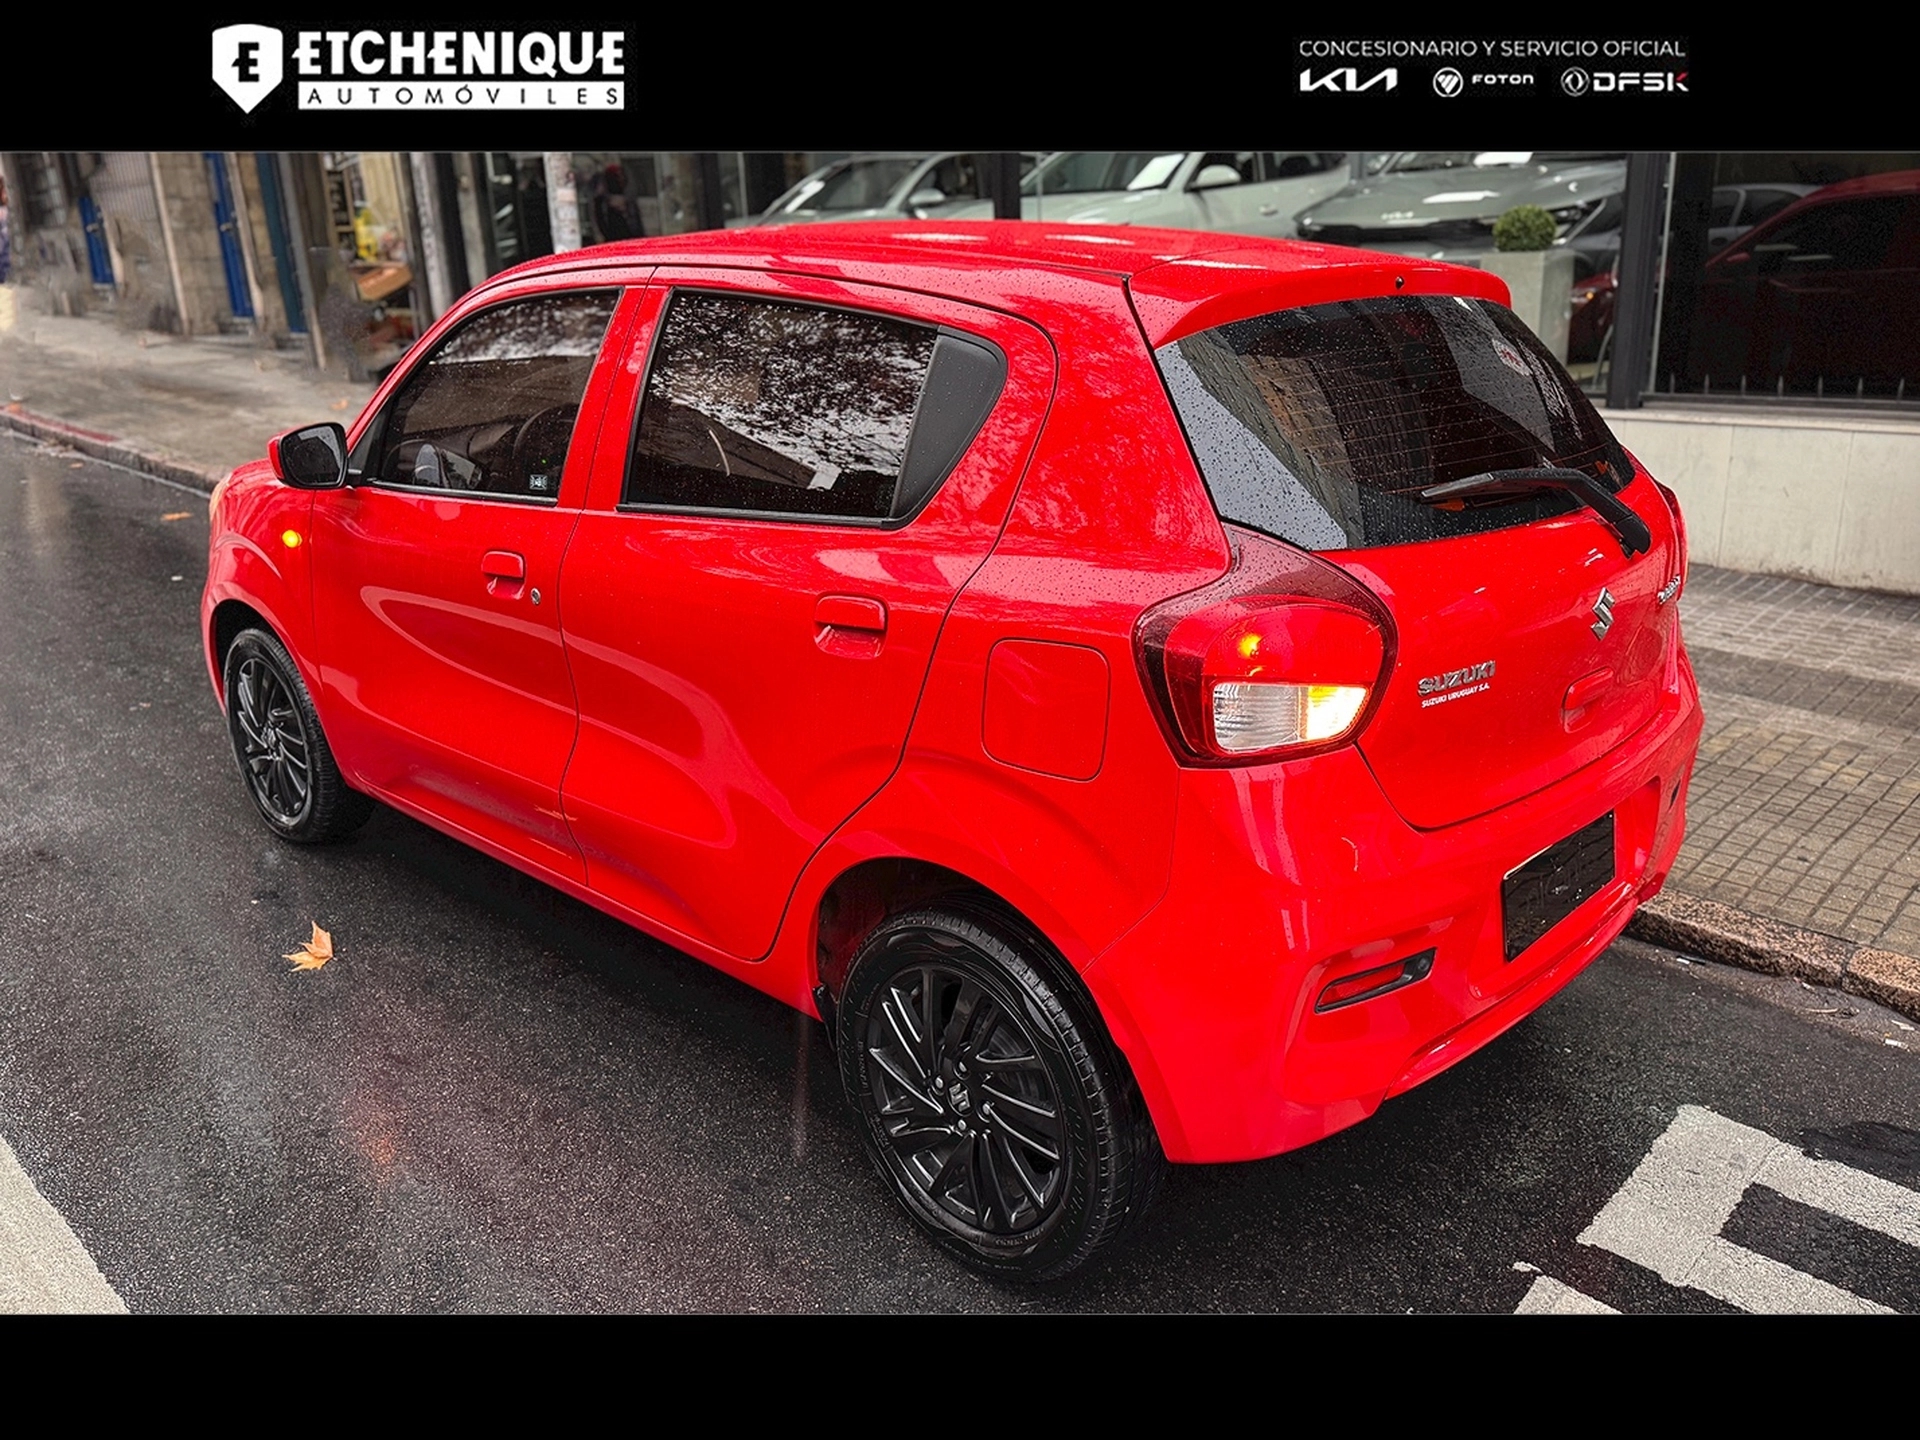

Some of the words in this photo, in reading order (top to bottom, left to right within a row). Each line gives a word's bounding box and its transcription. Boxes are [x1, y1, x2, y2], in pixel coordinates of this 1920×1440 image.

[1417, 660, 1496, 697] SUZUKI
[1421, 694, 1448, 709] SUZUKI
[1447, 686, 1479, 701] URUGUAY
